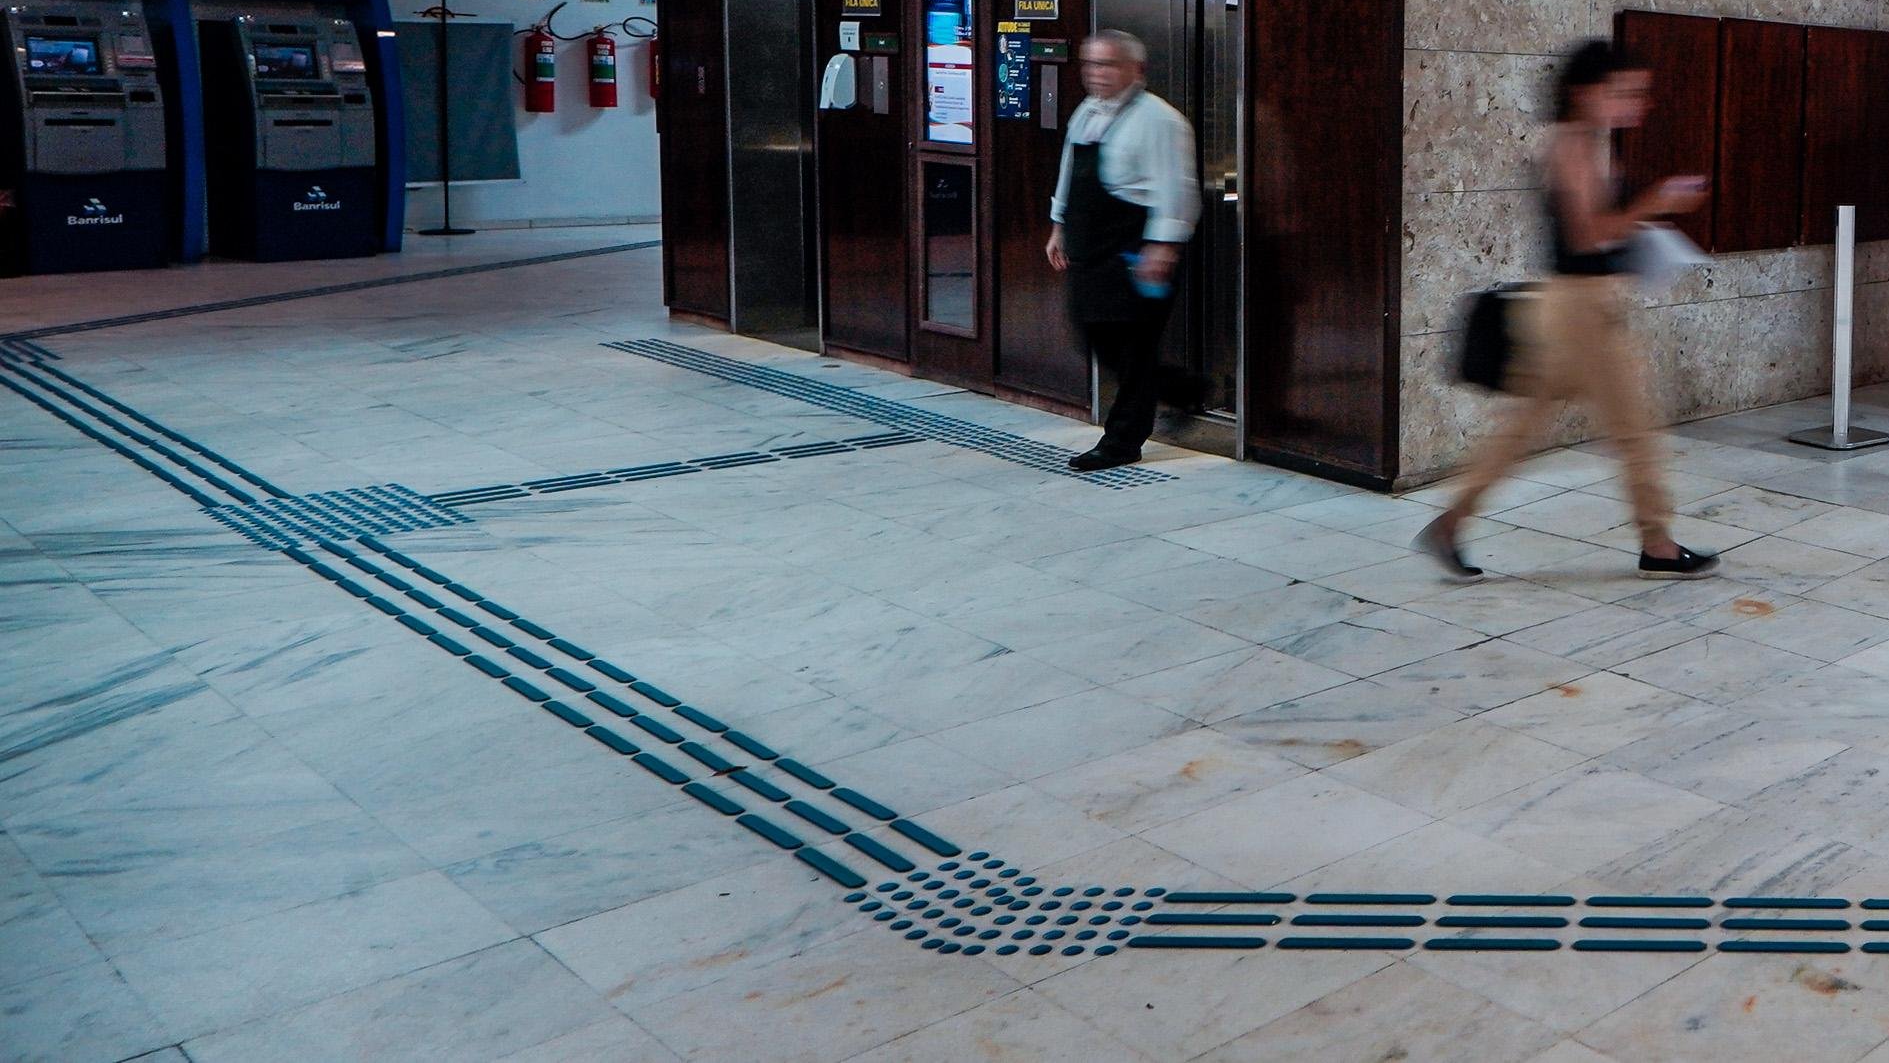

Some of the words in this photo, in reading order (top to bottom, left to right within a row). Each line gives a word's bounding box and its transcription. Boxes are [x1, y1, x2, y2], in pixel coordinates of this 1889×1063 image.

[1018, 0, 1032, 10] FILA
[292, 200, 341, 211] Banrisul
[66, 213, 124, 226] Banrisul
